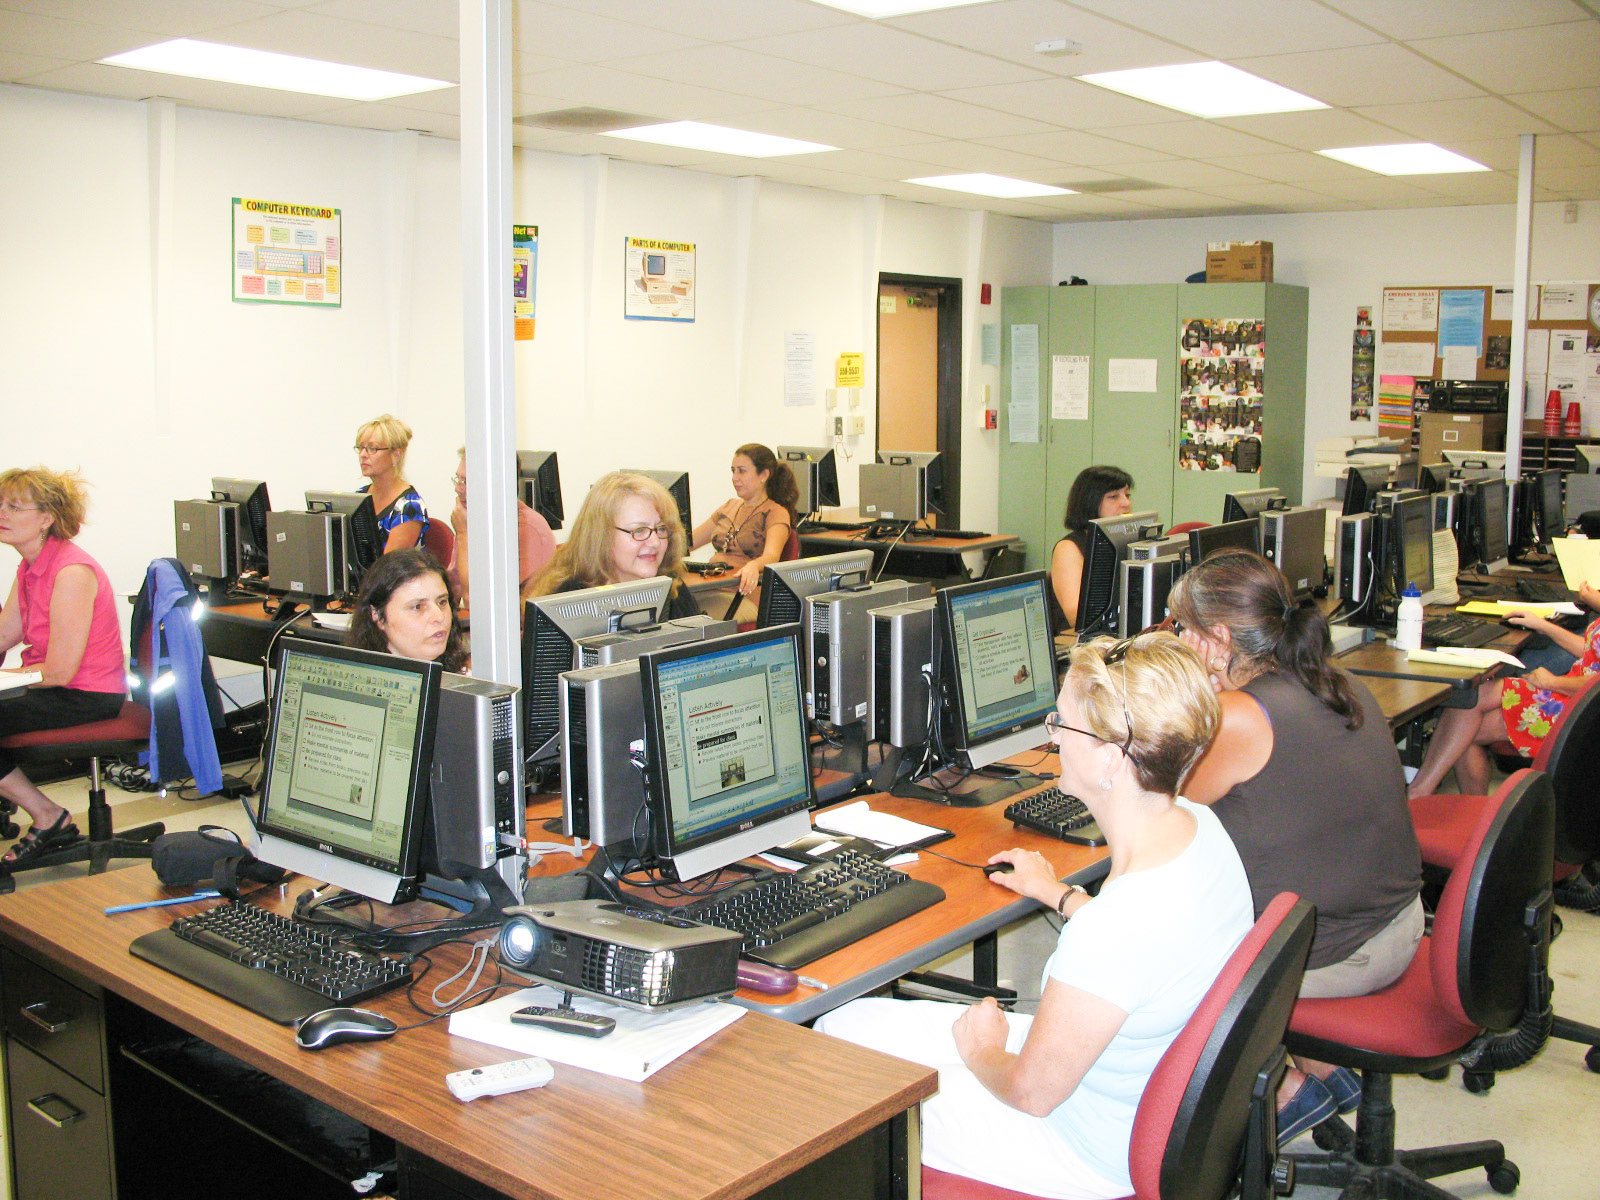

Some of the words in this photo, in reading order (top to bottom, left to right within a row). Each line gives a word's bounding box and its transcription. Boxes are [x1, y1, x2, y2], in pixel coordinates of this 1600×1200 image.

[246, 200, 289, 215] COMPUTER
[290, 205, 332, 218] KEYBOARD
[632, 238, 648, 248] PARTS
[663, 242, 690, 252] COMPUTER
[688, 704, 703, 713] Listen
[704, 699, 722, 709] Actively
[306, 708, 319, 717] Listen
[320, 711, 337, 721] Actively
[740, 821, 753, 830] DELL
[320, 843, 333, 853] DELL
